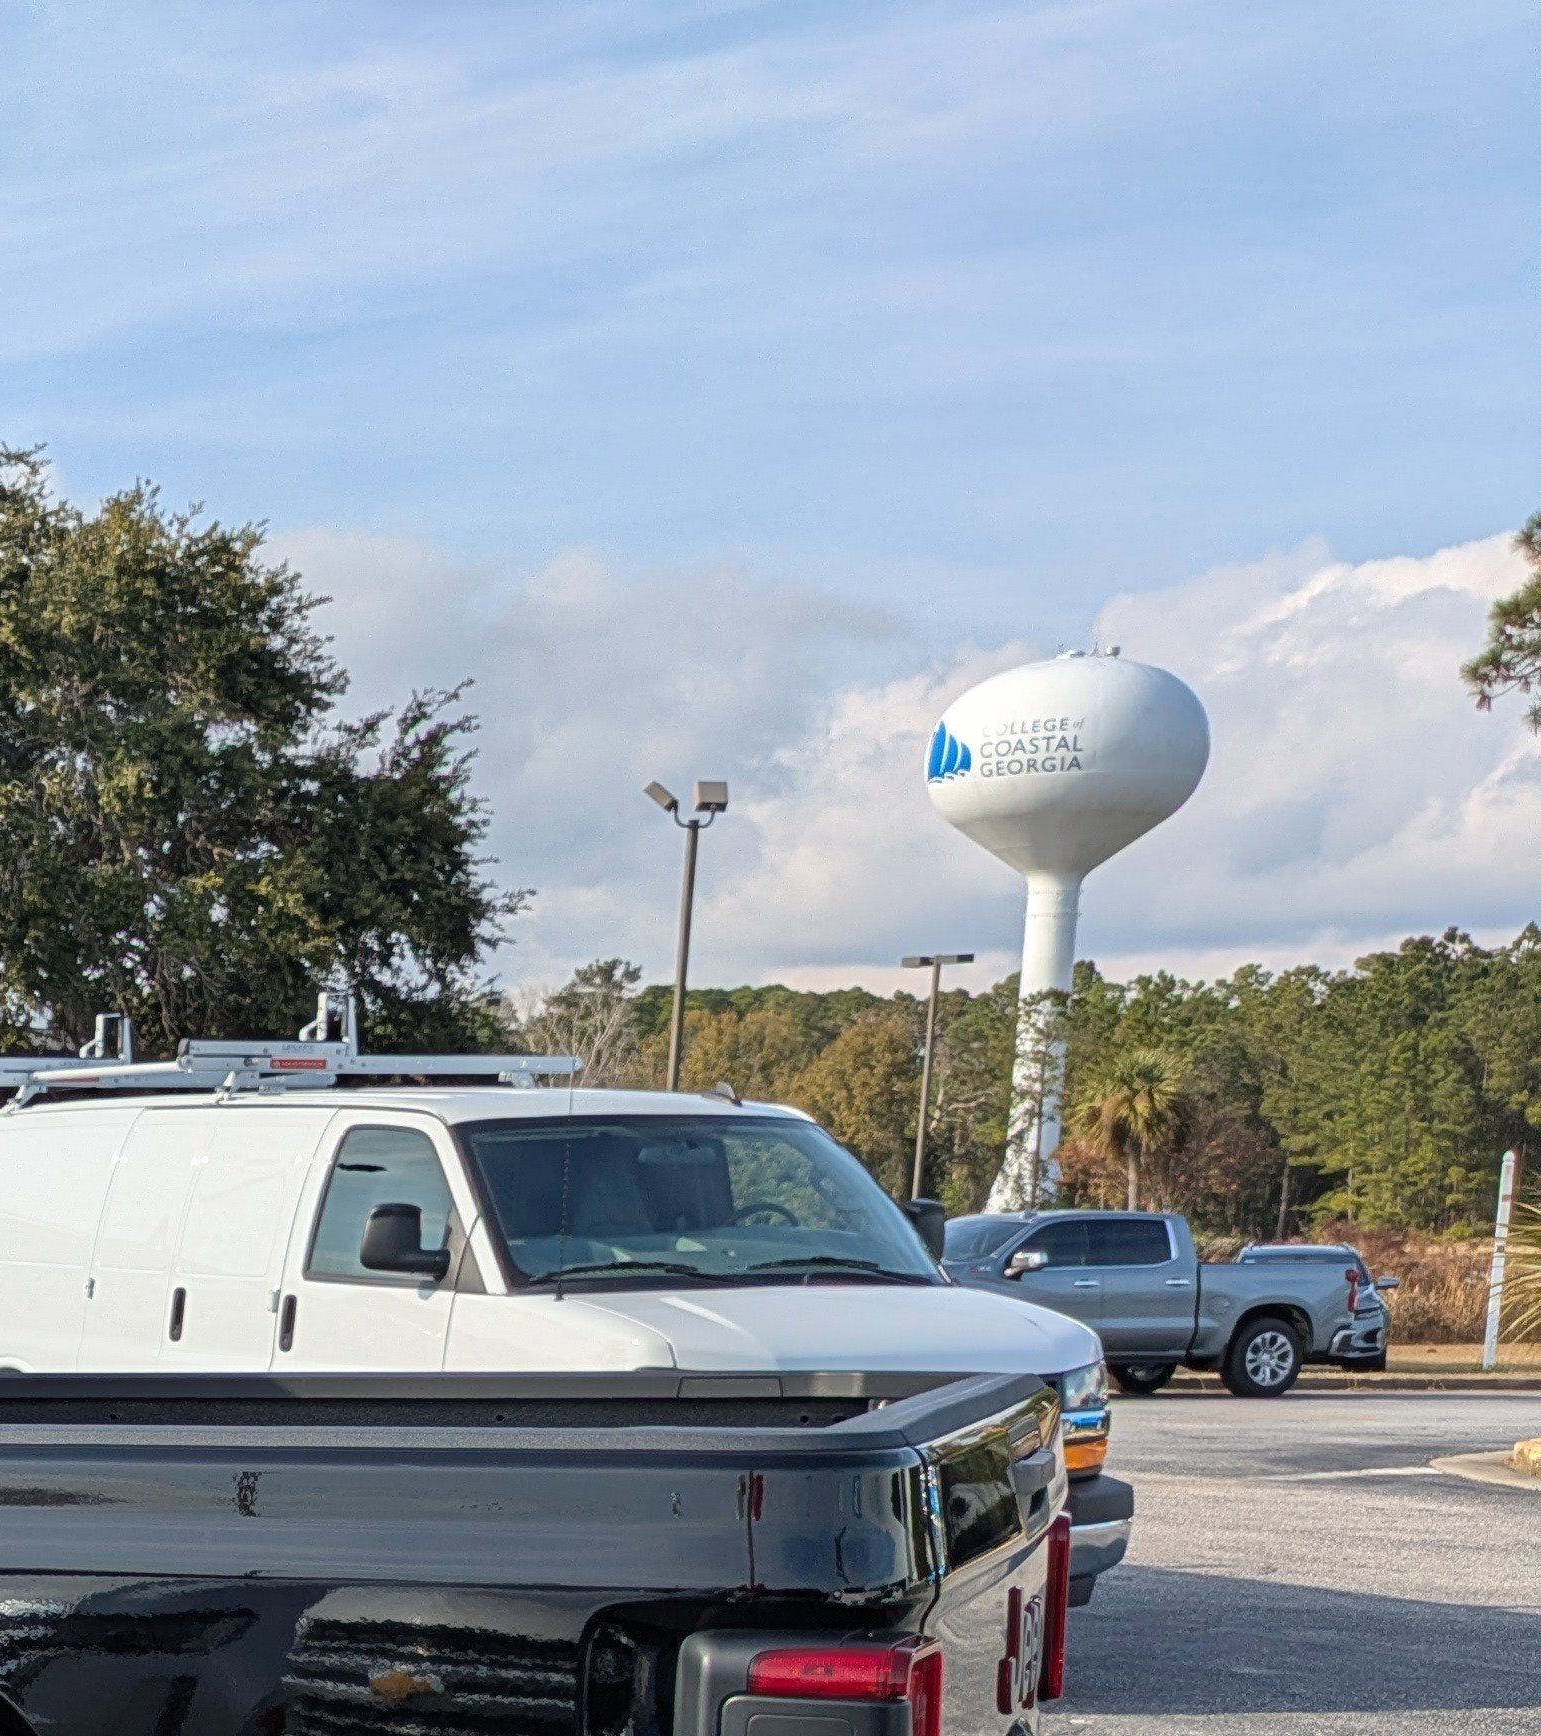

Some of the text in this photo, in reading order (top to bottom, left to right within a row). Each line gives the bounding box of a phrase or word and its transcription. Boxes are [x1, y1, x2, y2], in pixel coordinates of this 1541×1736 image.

[982, 716, 1069, 738] COLLEGE
[979, 734, 1083, 758] COASTAL
[979, 755, 1082, 778] GEORGIA
